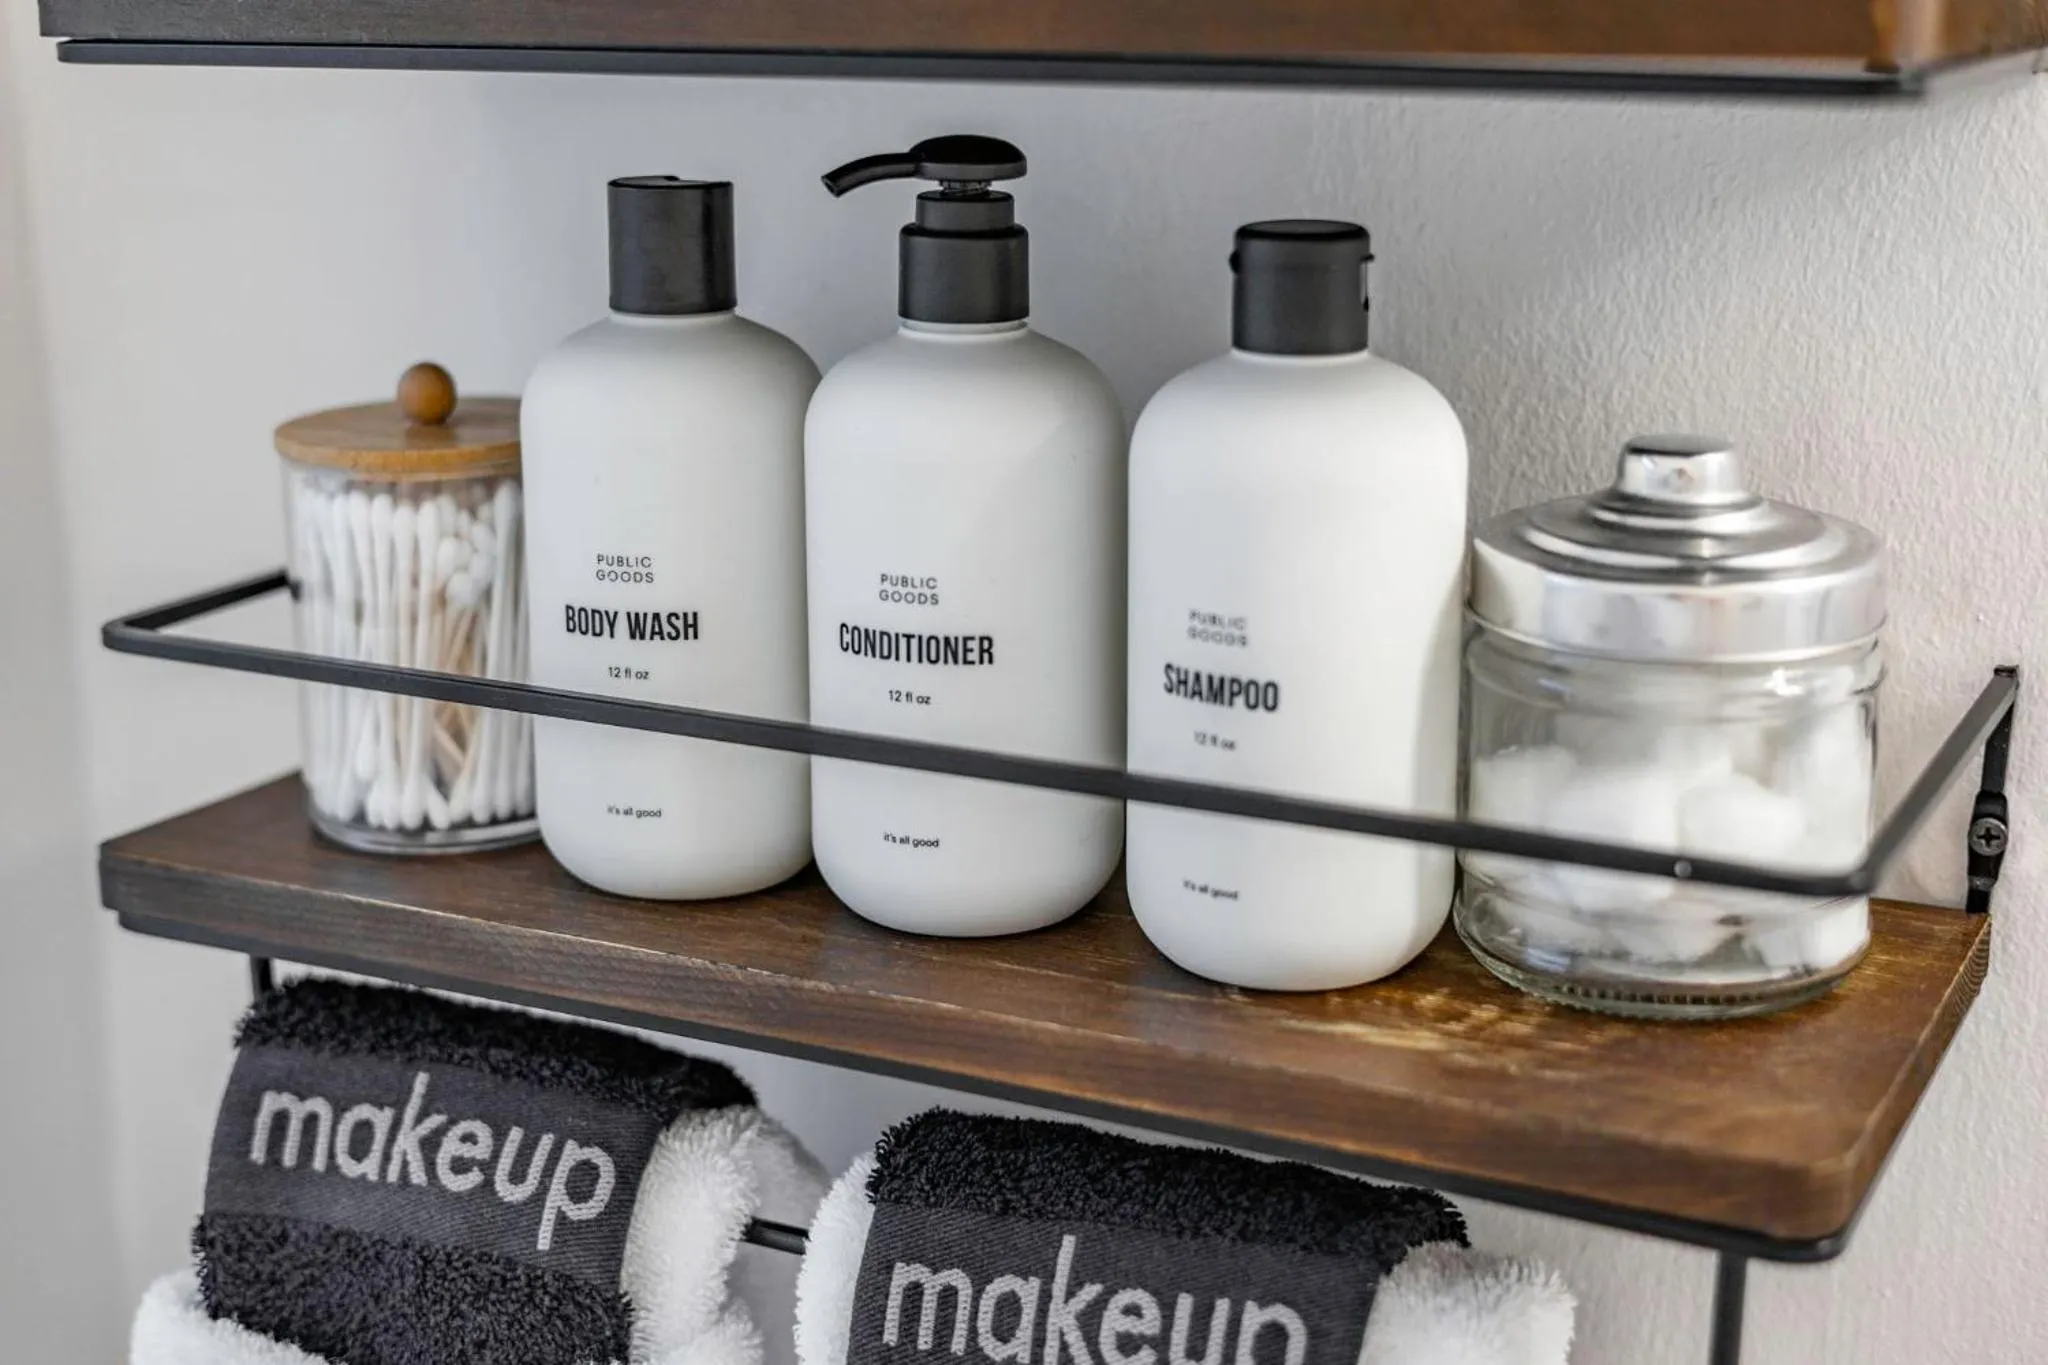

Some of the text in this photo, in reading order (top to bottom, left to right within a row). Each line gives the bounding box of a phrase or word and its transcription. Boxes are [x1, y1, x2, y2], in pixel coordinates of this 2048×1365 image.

[597, 554, 652, 568] PUBLIC
[596, 569, 655, 584] GOODS
[881, 573, 937, 589] PUBLIC
[879, 589, 939, 605] GOODS
[565, 604, 699, 641] BODY WASH
[1188, 610, 1245, 630] PUBLIC
[839, 622, 994, 666] CONDITIONER
[1187, 626, 1247, 648] GOODS
[608, 667, 649, 681] 12 fl oz
[1163, 662, 1280, 713] SHAMPOO
[888, 690, 931, 705] 12 fl oz
[1194, 731, 1207, 745] 12
[623, 806, 633, 817] all
[635, 808, 662, 819] good
[884, 832, 940, 849] it's all good
[1210, 888, 1239, 902] good
[249, 1071, 616, 1251] makeup
